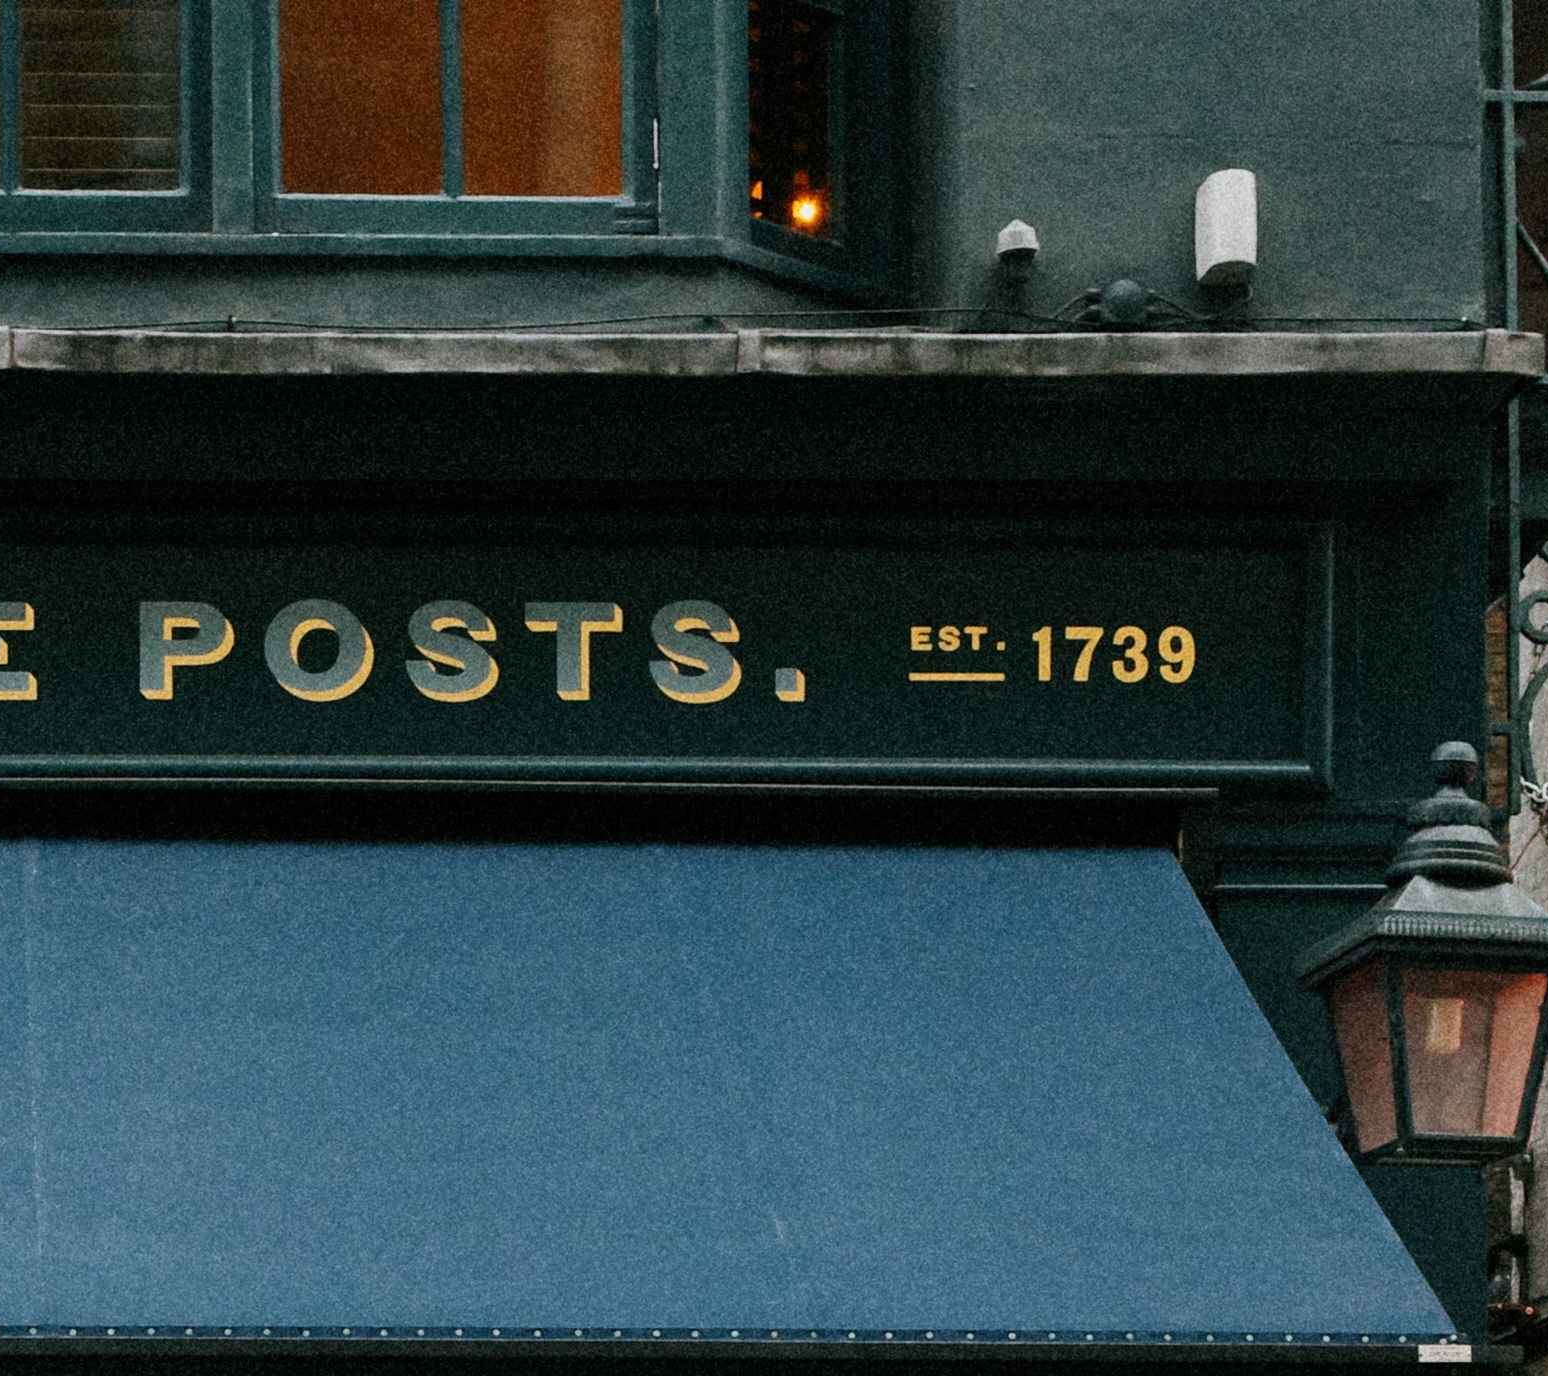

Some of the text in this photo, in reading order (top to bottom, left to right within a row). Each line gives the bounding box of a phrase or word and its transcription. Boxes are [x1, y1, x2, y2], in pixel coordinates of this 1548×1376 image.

[140, 599, 805, 704] POSTS.
[910, 625, 1005, 652] EST.
[1032, 625, 1196, 684] 1739
